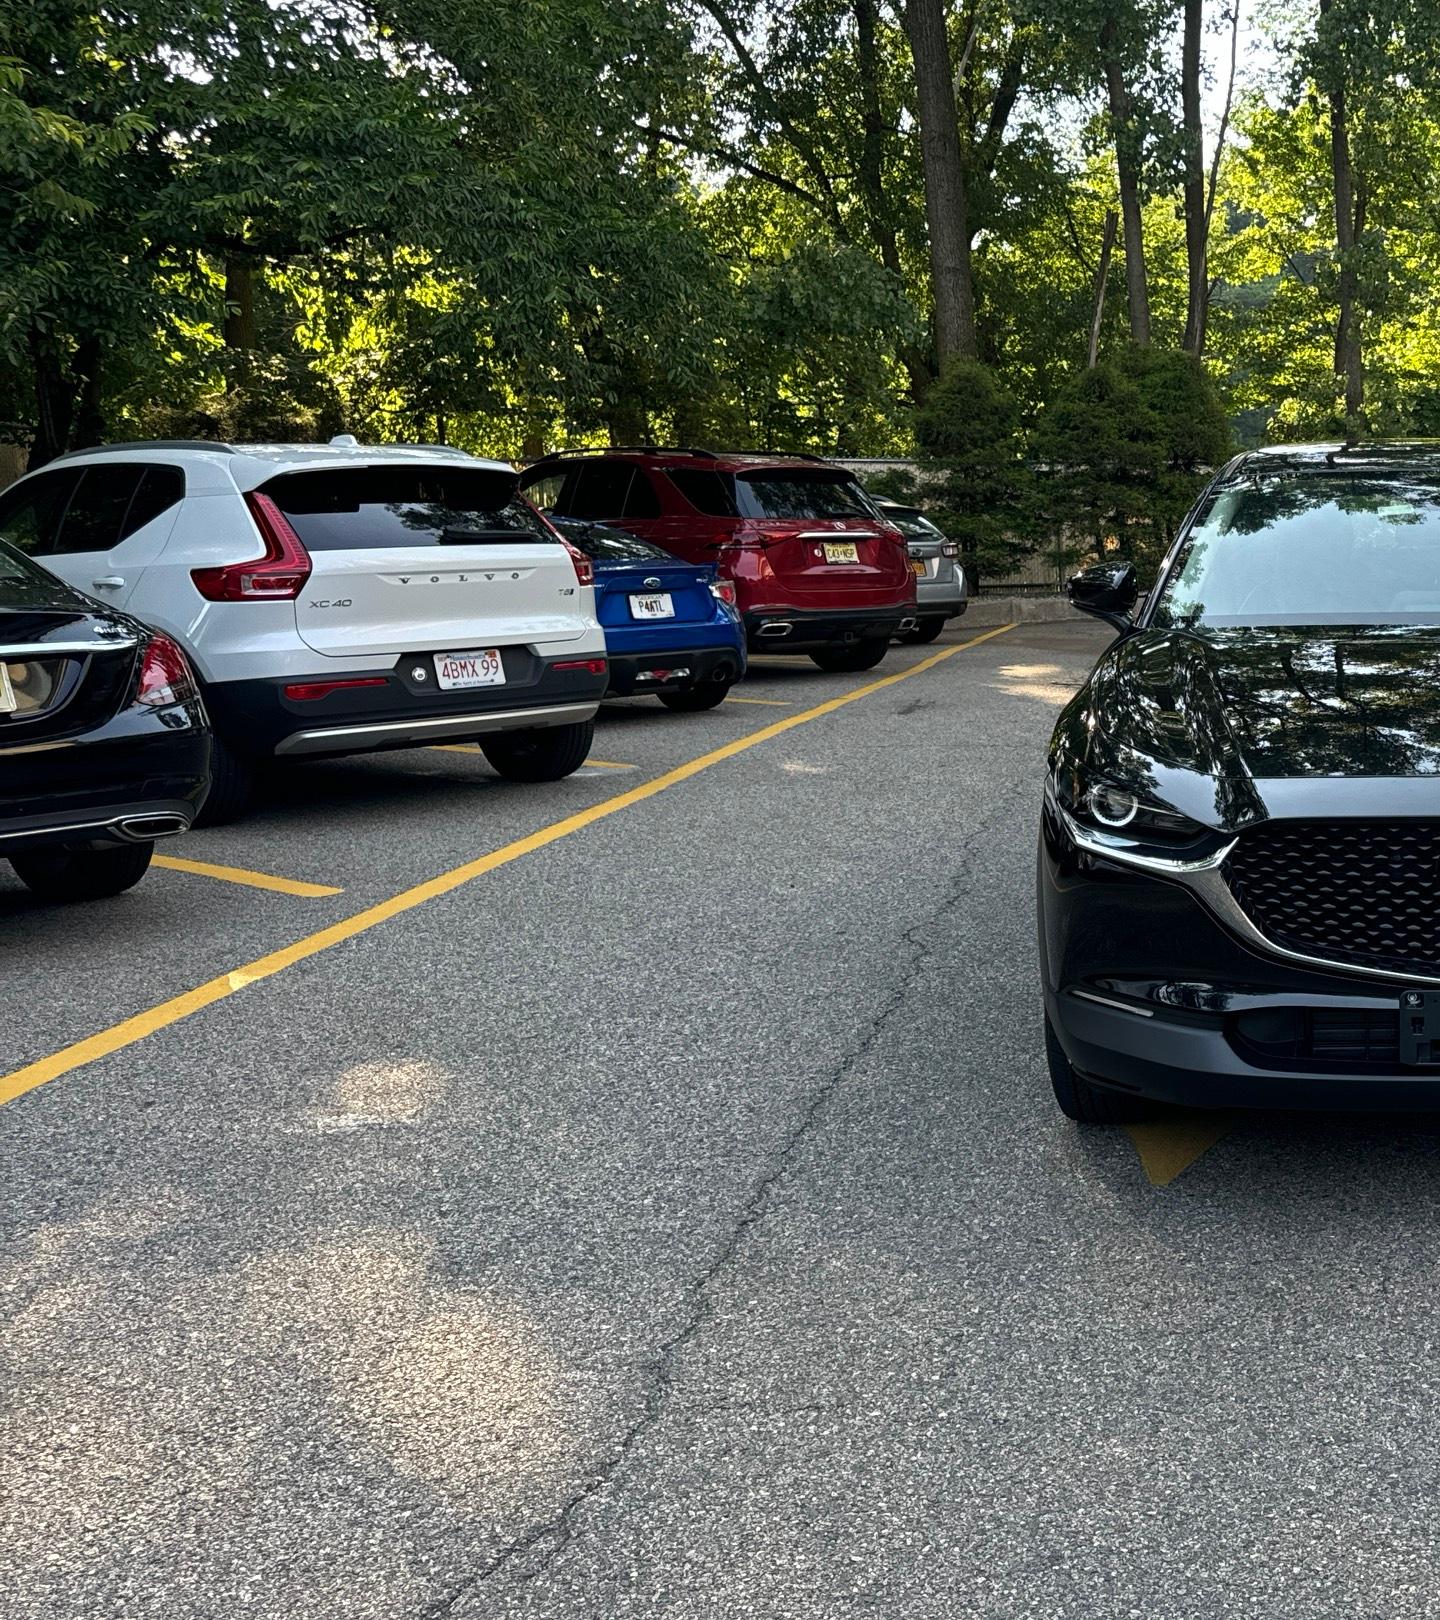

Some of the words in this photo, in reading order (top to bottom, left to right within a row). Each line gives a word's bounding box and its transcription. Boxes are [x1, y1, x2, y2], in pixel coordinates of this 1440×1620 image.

[398, 572, 520, 584] VOLVO
[443, 660, 479, 680] 4BMX
[481, 659, 499, 676] 99
